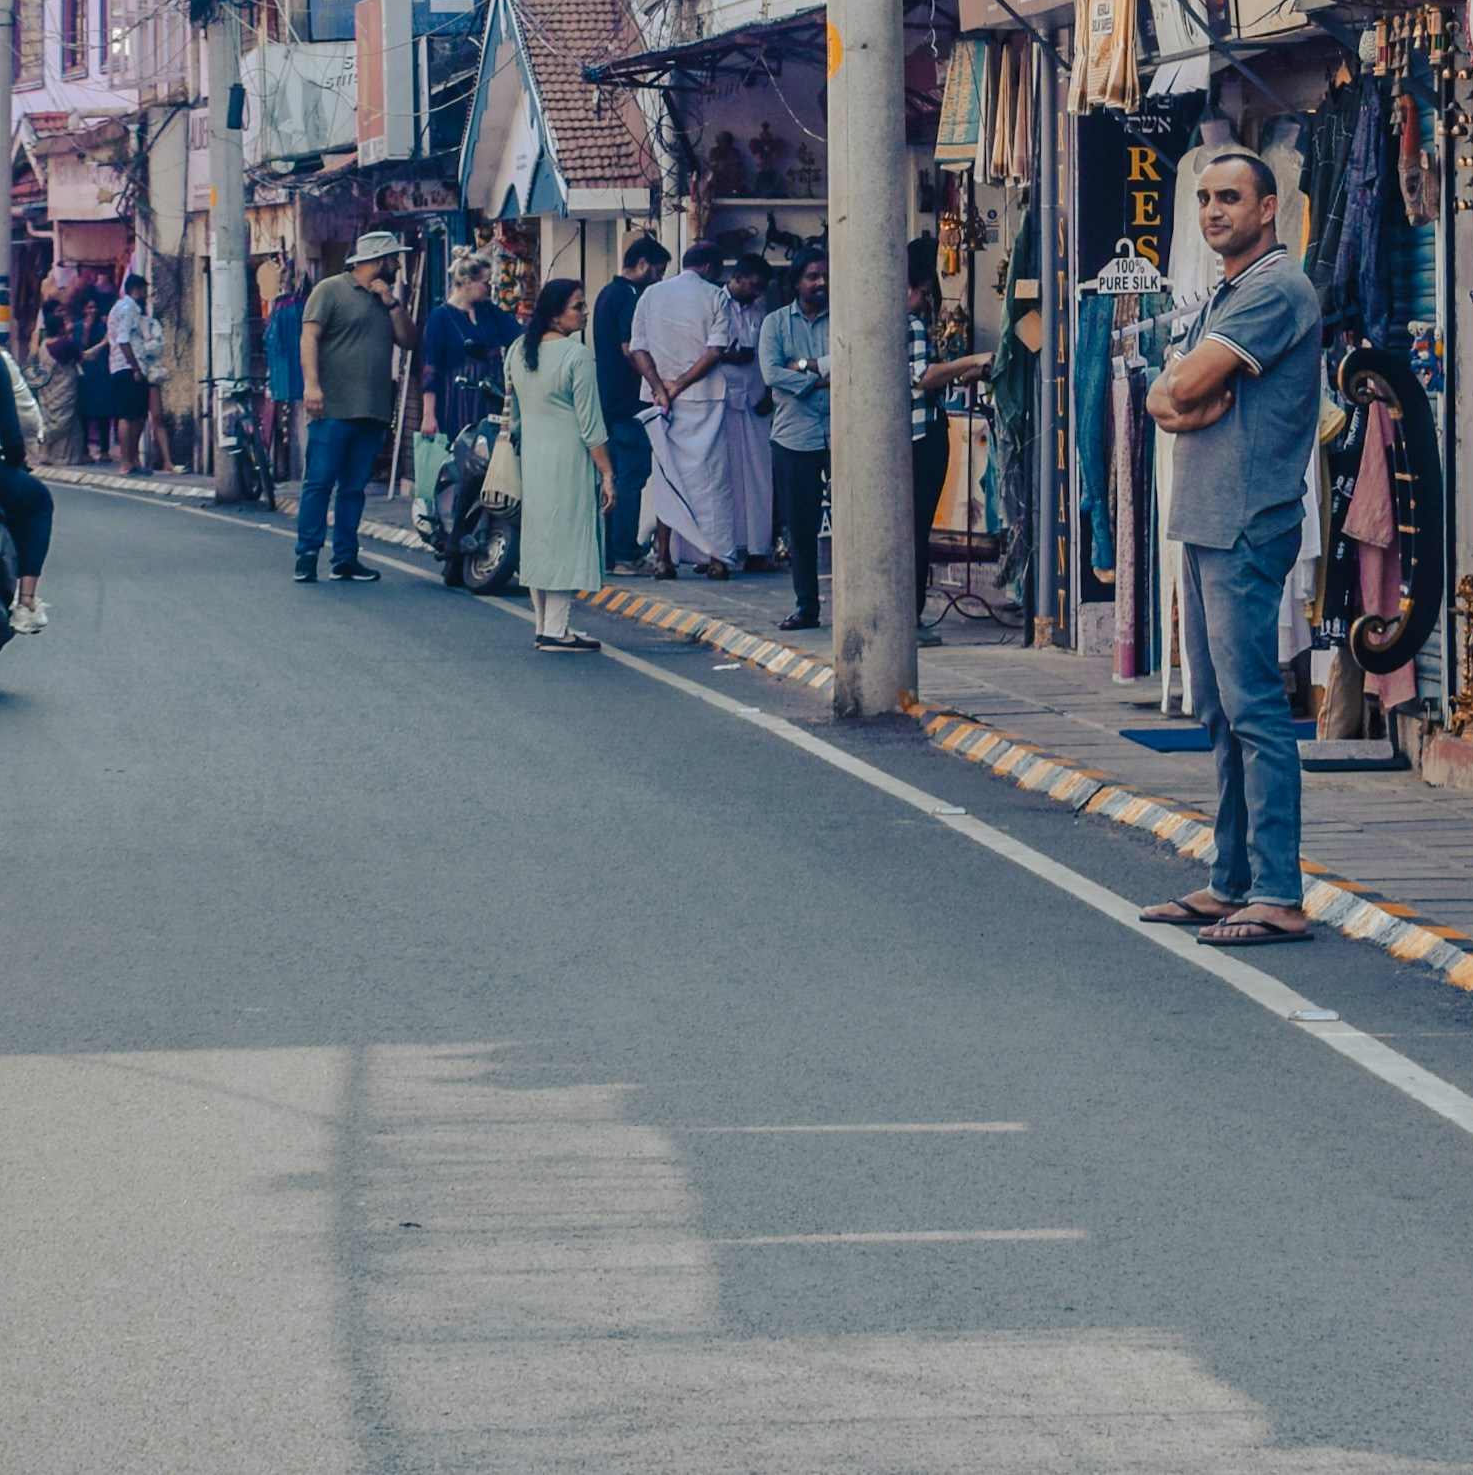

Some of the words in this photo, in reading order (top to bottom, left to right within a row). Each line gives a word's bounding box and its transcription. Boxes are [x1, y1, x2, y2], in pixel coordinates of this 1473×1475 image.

[1114, 258, 1145, 274] 100%
[1099, 276, 1129, 291] PURE
[1132, 275, 1158, 290] SILK
[1056, 112, 1065, 630] RESTAURANT
